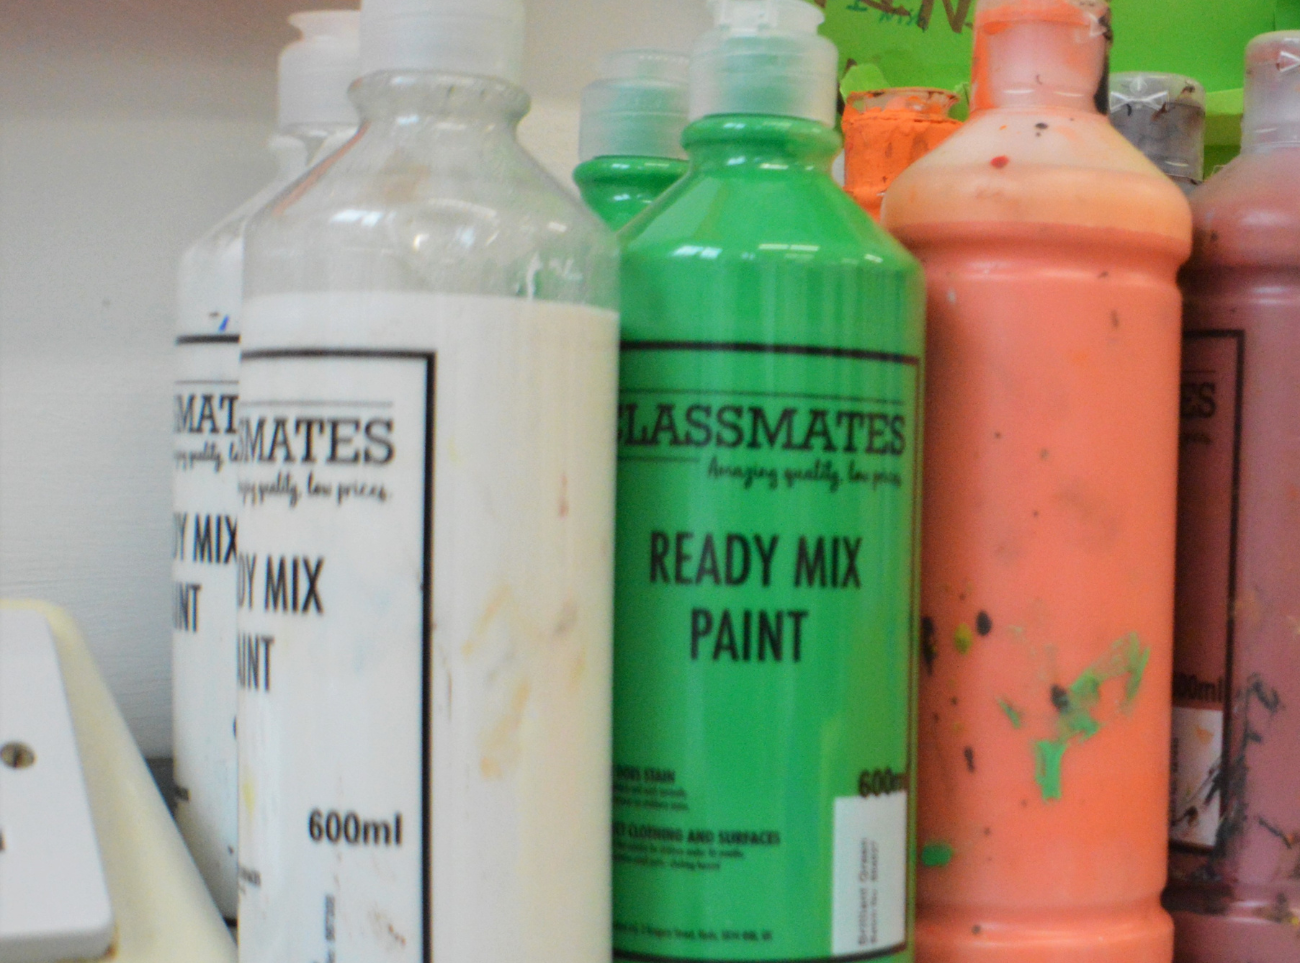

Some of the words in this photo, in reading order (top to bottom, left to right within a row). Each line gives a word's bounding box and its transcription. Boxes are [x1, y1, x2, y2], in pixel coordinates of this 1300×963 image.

[307, 471, 332, 496] low
[193, 513, 238, 566] MIX
[650, 530, 779, 588] READY
[794, 535, 862, 590] MIX
[264, 555, 324, 616] MIX
[690, 607, 809, 663] PAINT
[308, 808, 403, 846] 600ml
[687, 828, 714, 844] AND
[718, 829, 781, 846] SURFACES
